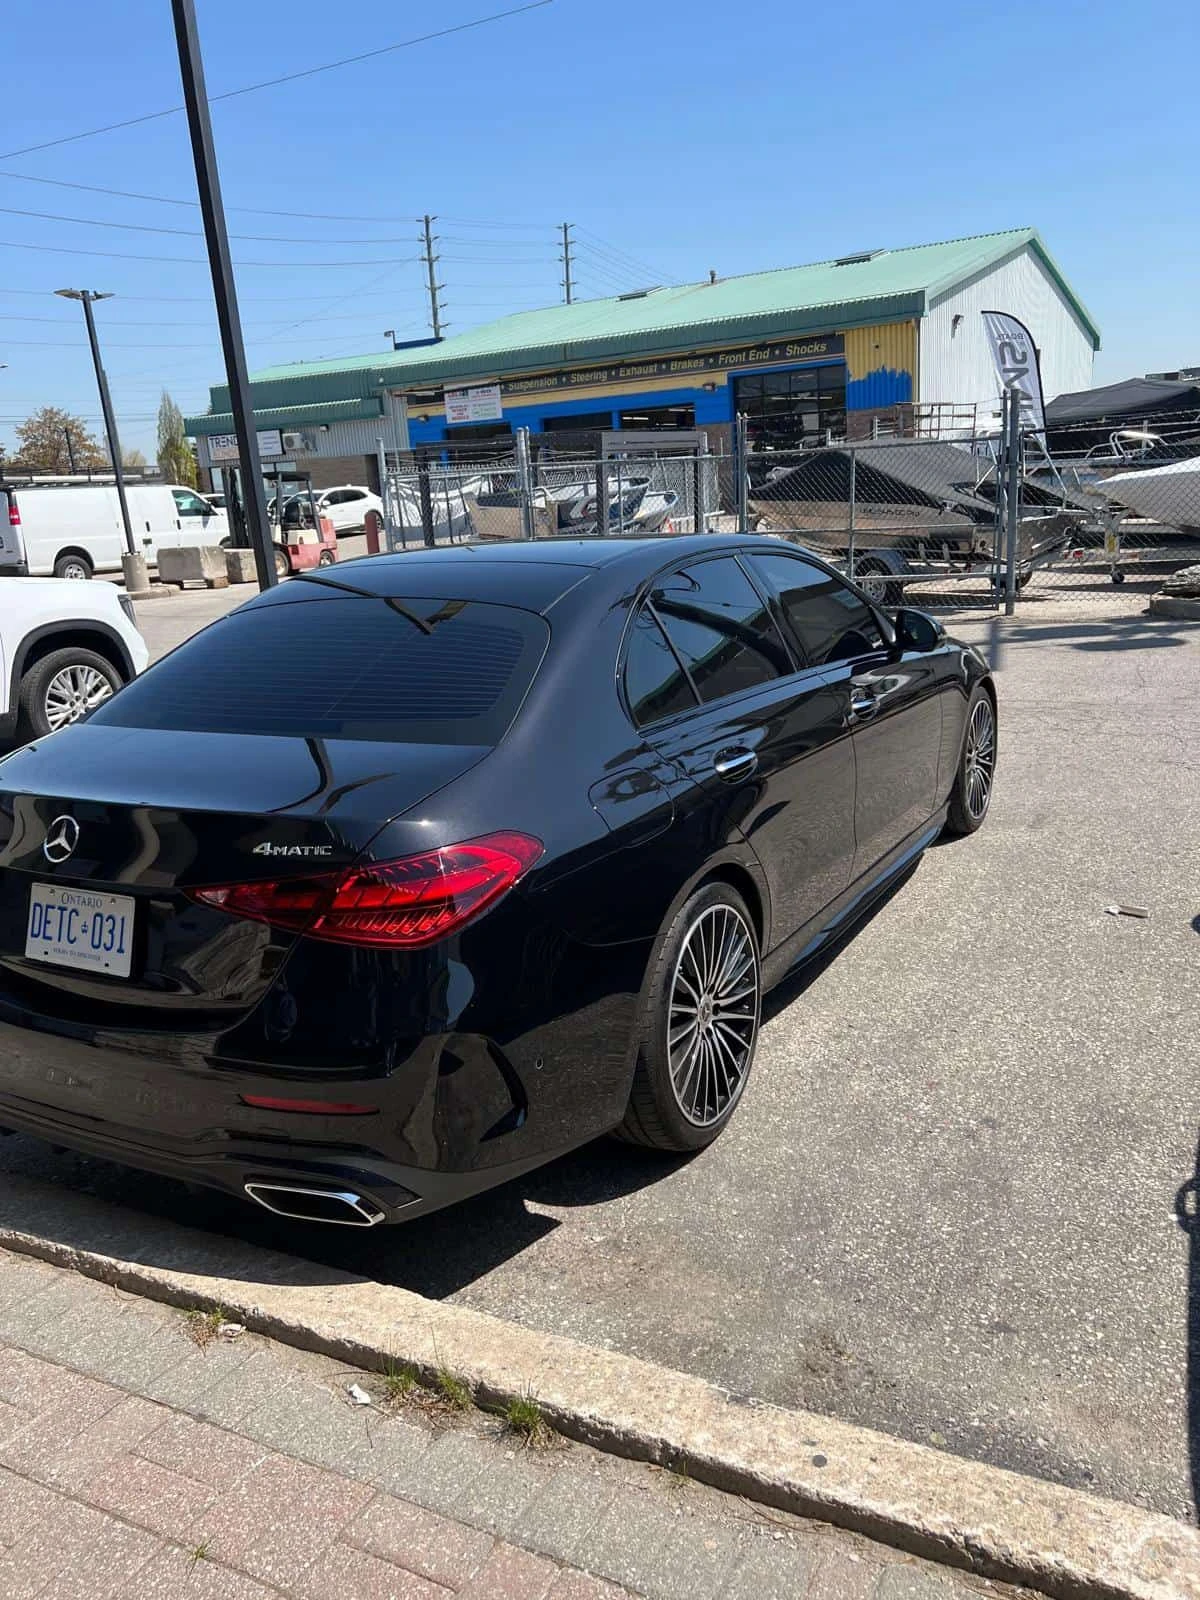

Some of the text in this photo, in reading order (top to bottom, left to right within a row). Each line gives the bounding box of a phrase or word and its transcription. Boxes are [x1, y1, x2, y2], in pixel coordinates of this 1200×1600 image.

[509, 341, 827, 391] Suspension Steering Exhaust Brakes Front End Shocks
[252, 842, 332, 856] 4MATIC
[61, 891, 103, 909] ONTARIO
